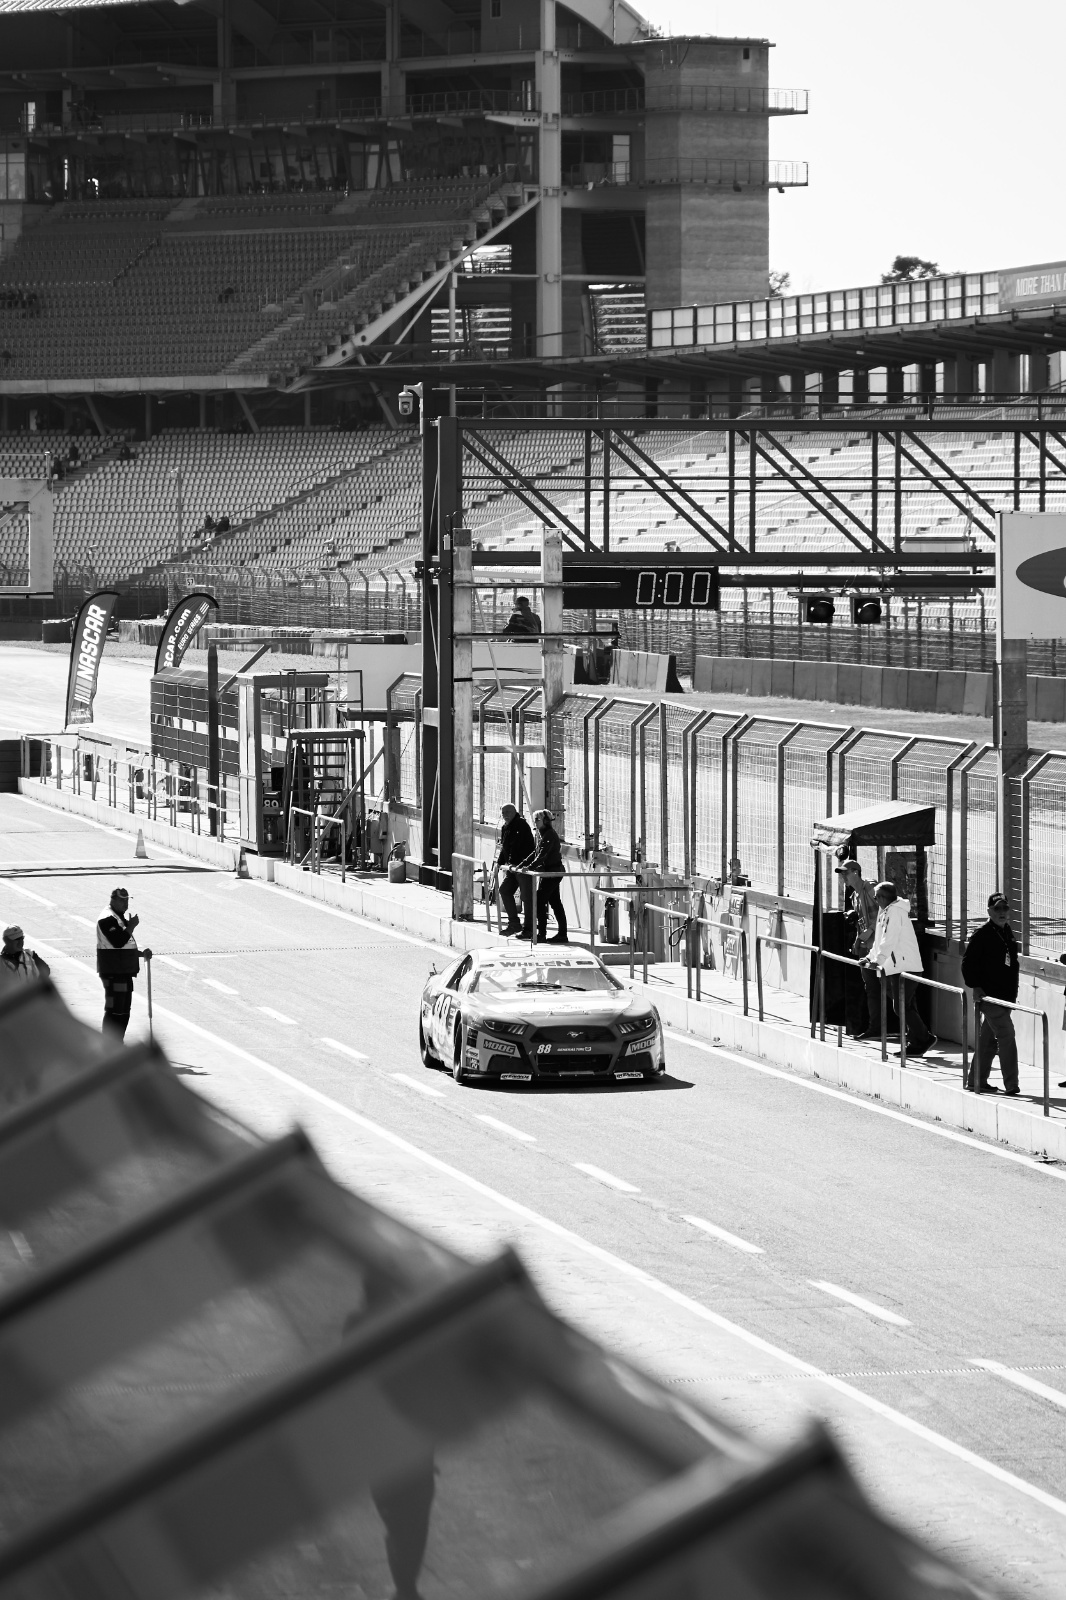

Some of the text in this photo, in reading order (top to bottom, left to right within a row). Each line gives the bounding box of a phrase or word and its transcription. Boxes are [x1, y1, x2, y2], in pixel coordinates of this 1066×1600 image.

[1015, 276, 1039, 297] MORE
[1040, 272, 1062, 294] THAN
[635, 571, 712, 605] 0:00
[76, 603, 107, 681] NASCAR
[177, 613, 202, 650] EURO SERIES
[499, 960, 571, 968] WHELEN
[483, 1040, 516, 1055] MOOG
[536, 1043, 552, 1054] 88
